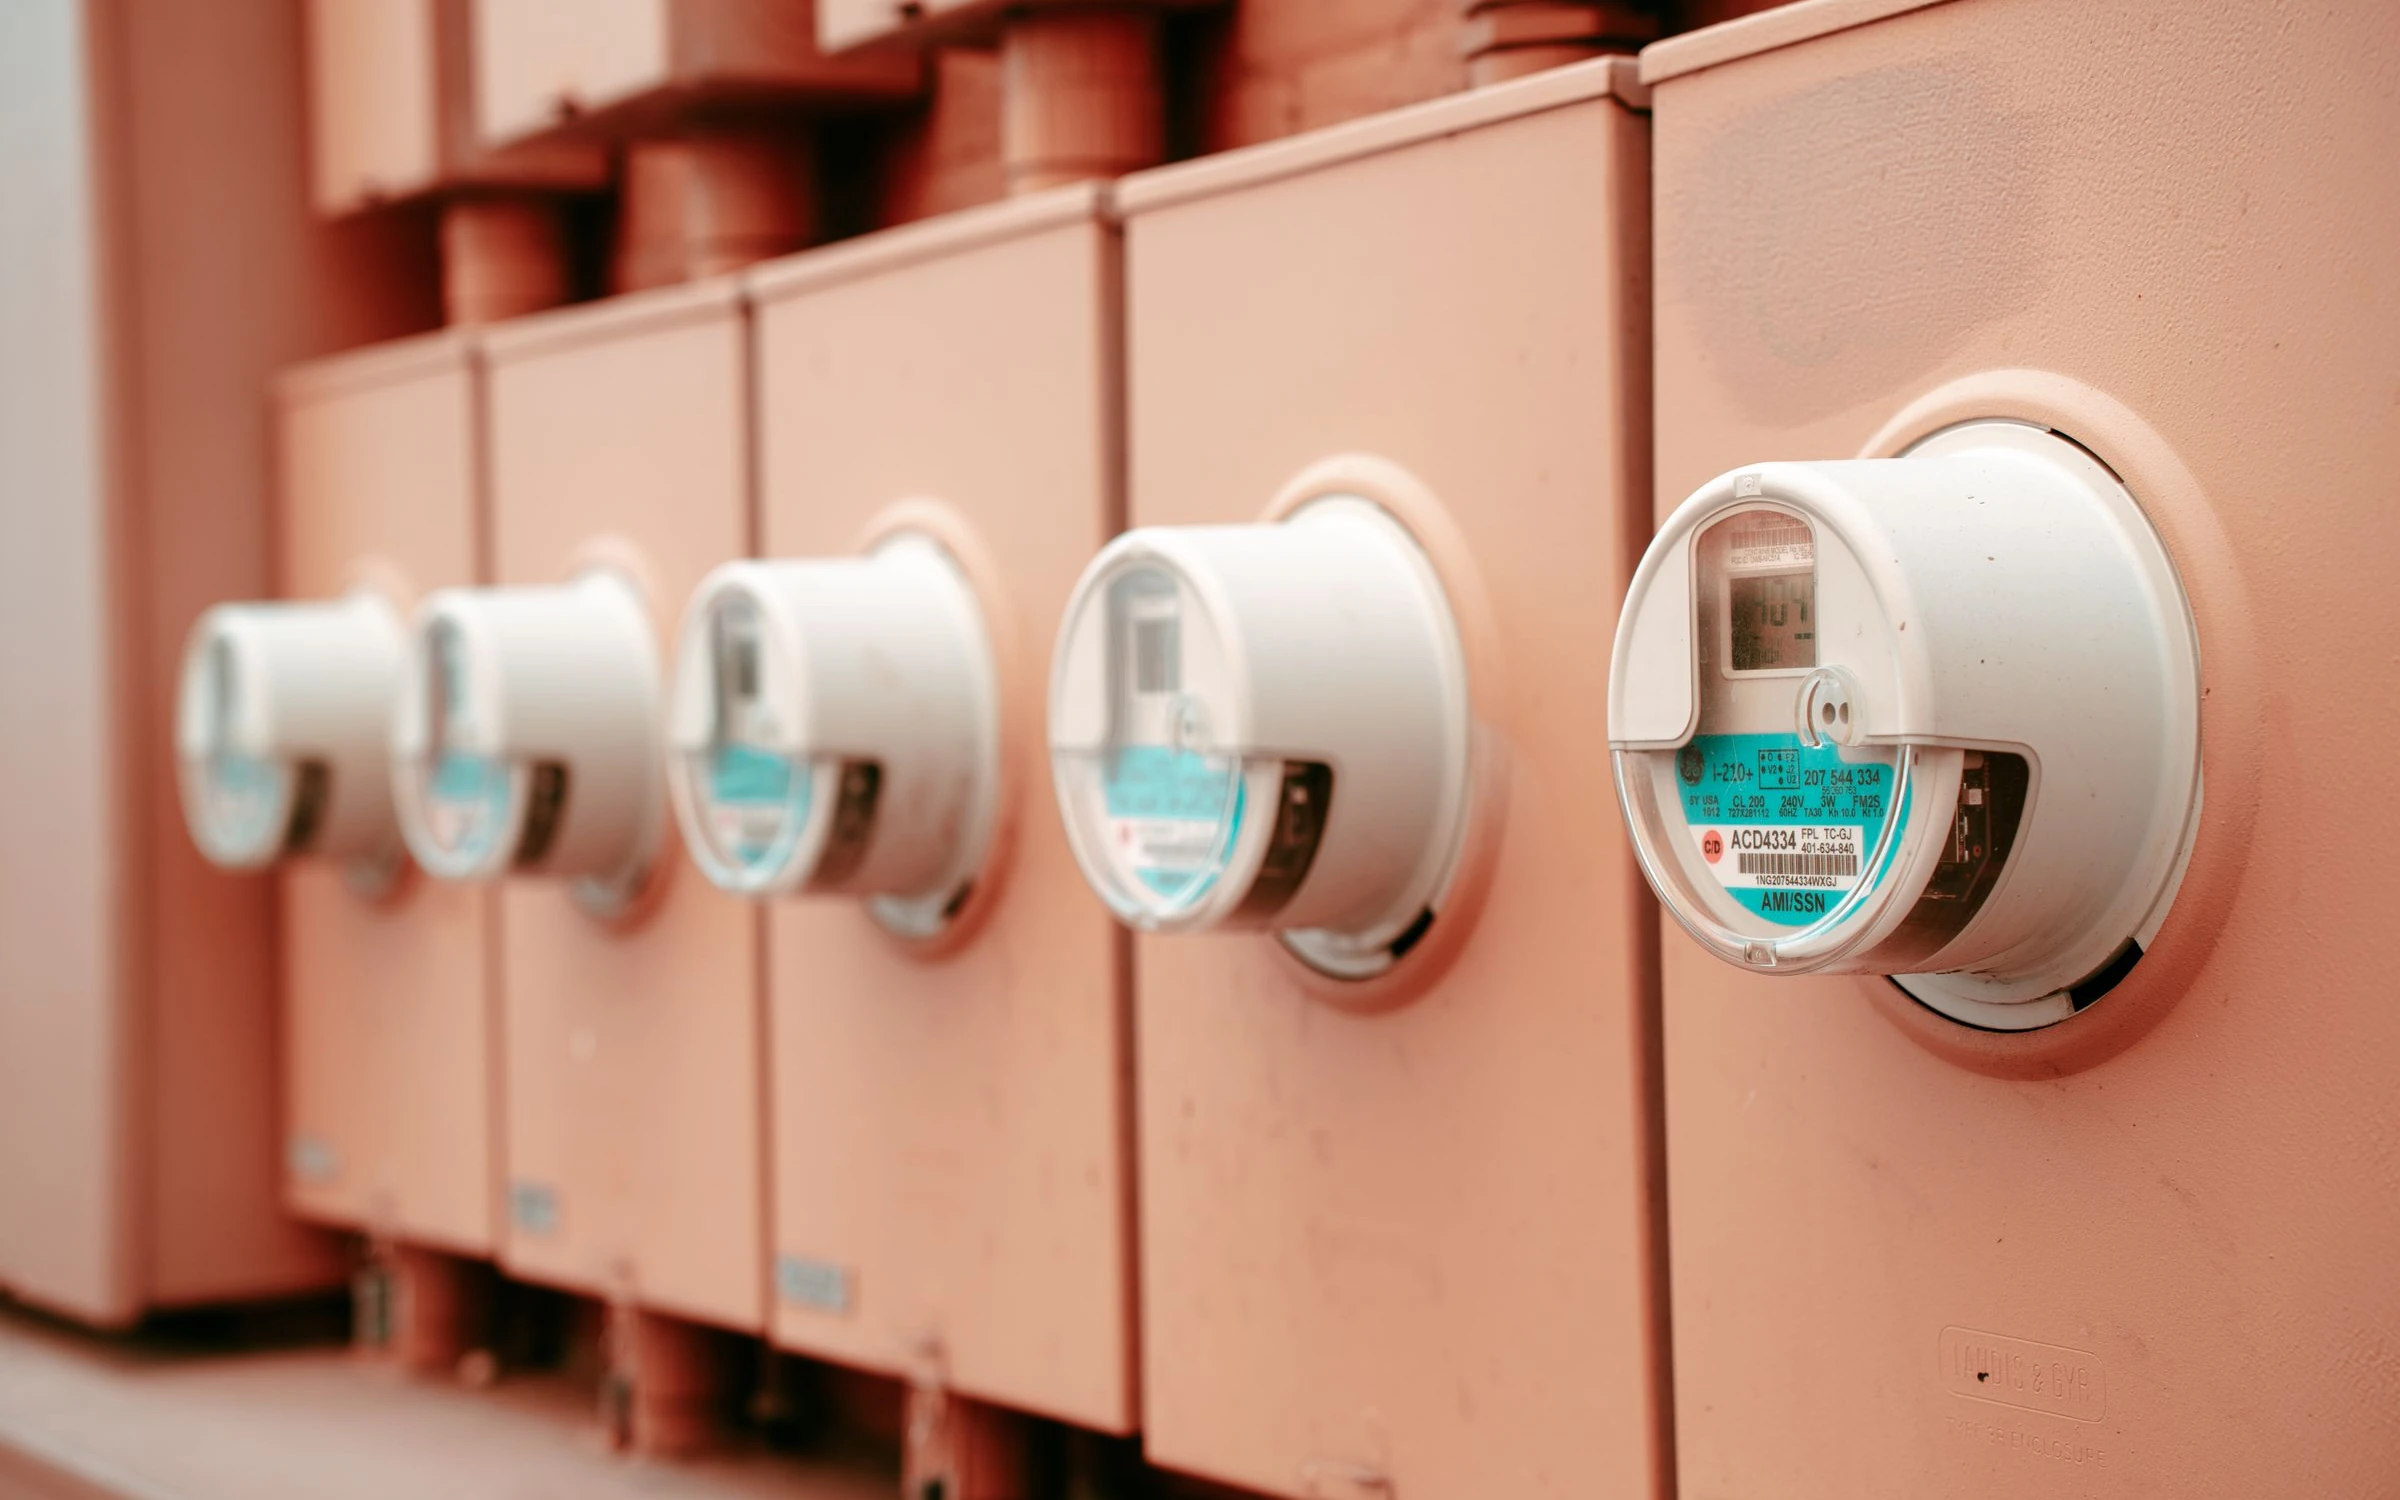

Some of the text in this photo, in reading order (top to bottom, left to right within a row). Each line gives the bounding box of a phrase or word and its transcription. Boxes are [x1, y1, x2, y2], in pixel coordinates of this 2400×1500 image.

[1804, 769, 1880, 786] 207 544 334
[1702, 795, 1719, 805] USA
[1732, 795, 1765, 807] CL 200
[1781, 796, 1804, 808] 240V
[1820, 796, 1836, 807] 3W
[1852, 795, 1880, 808] FM2S
[1804, 808, 1822, 817] TA30
[1828, 808, 1838, 817] Kh
[1731, 829, 1797, 850] ACD4334
[1801, 828, 1852, 840] FPL TC-GJ
[1704, 840, 1721, 854] C/D
[1801, 842, 1855, 854] 401-634-840
[1761, 891, 1825, 913] AMI/SSN
